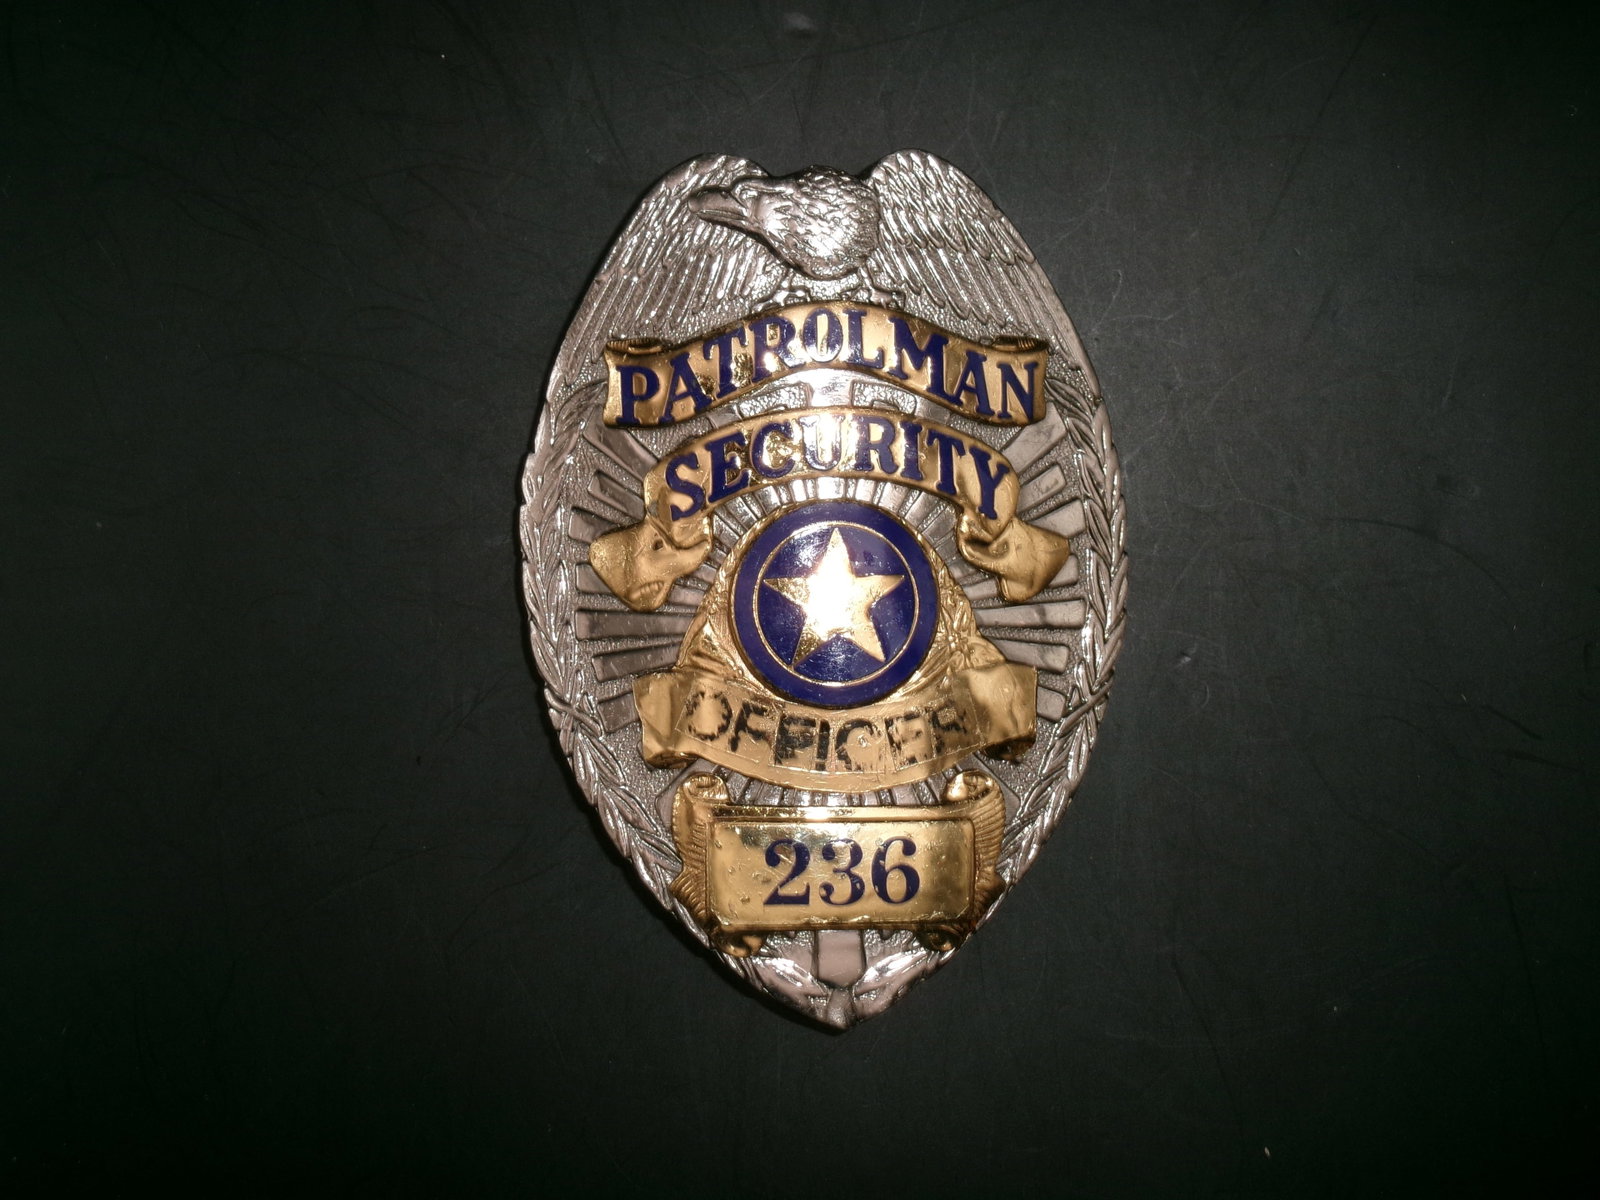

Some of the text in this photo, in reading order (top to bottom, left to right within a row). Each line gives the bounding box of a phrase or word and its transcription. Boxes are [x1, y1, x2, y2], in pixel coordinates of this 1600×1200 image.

[615, 308, 1038, 425] PATROLMAN
[665, 416, 1009, 520] SECURITY
[687, 689, 967, 769] OFFICER
[763, 837, 920, 906] 236
